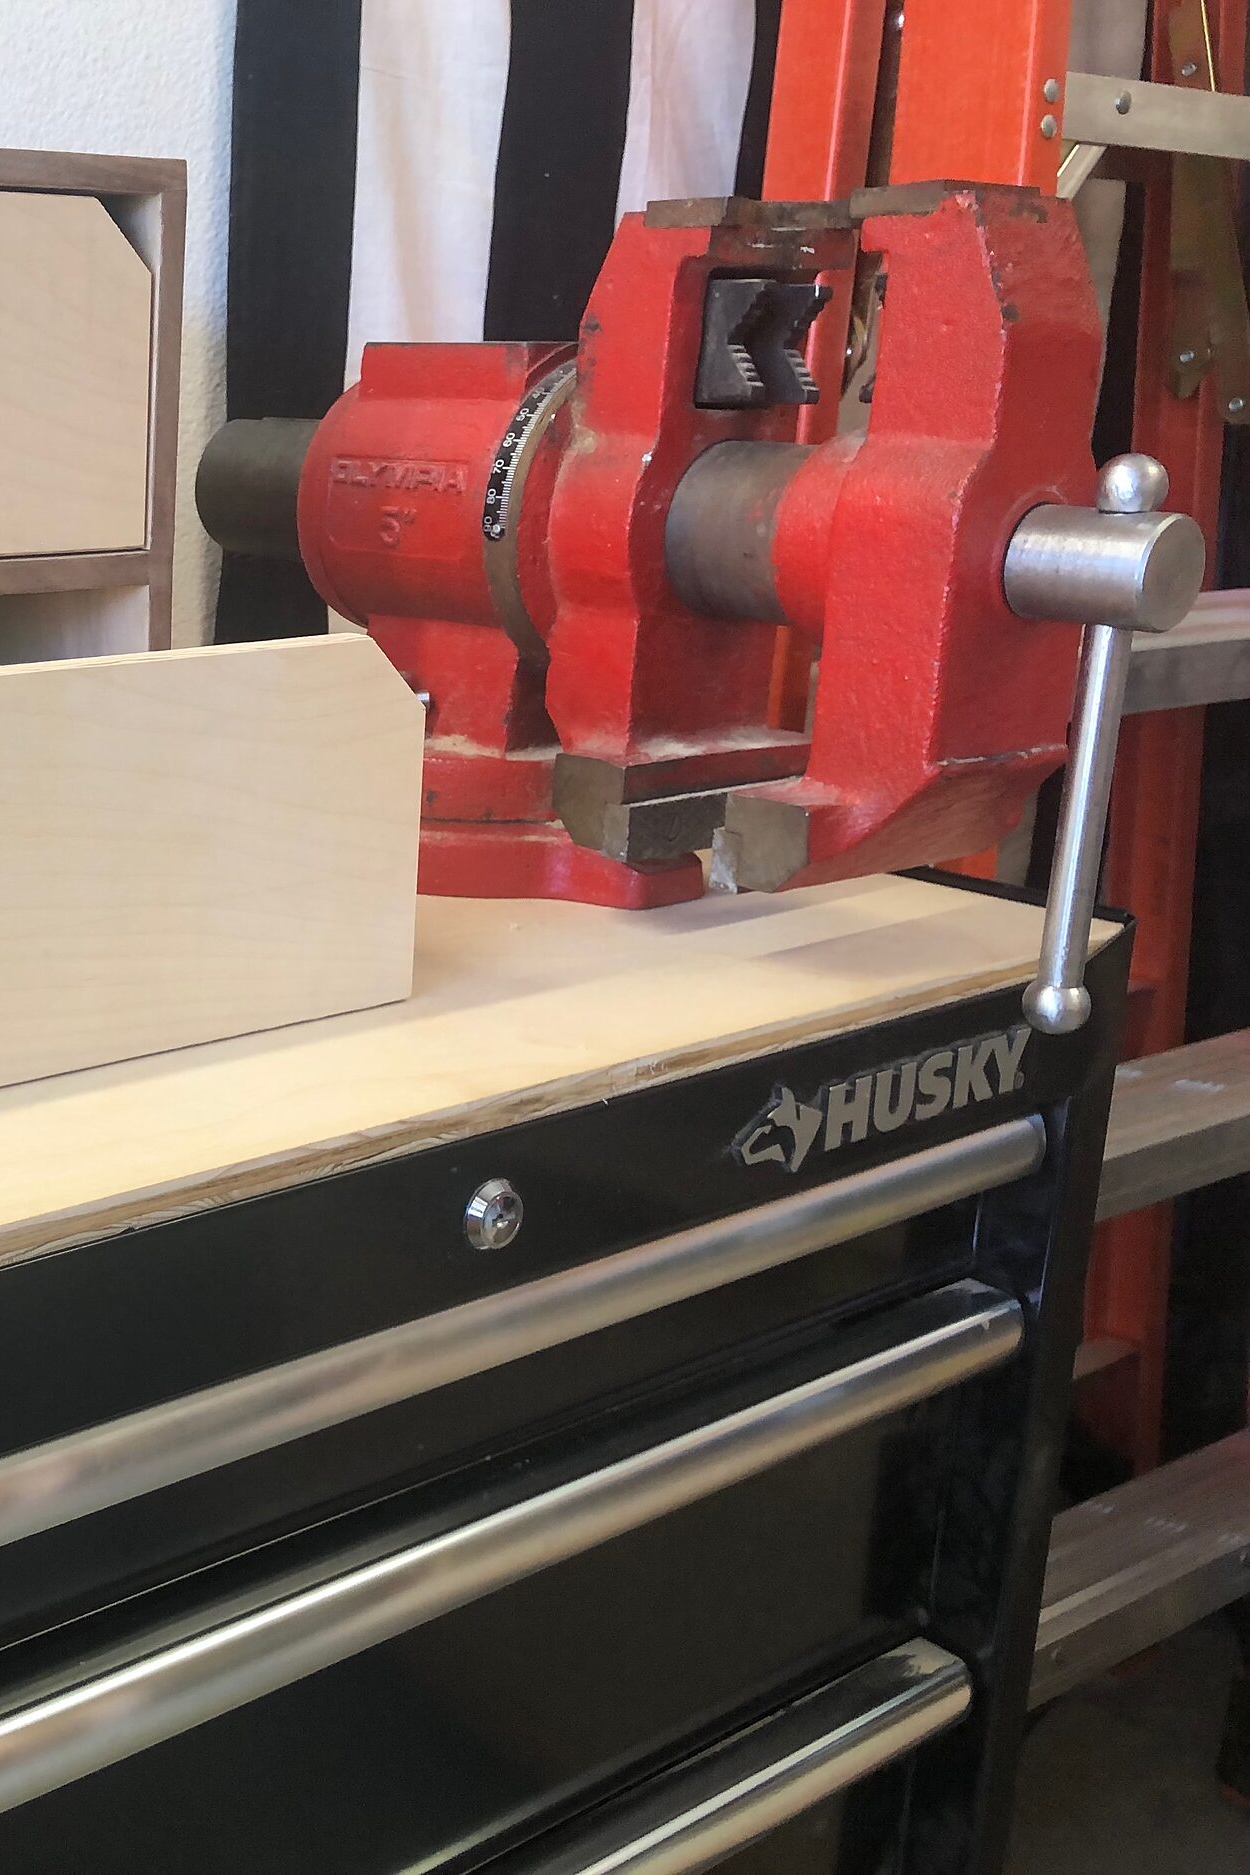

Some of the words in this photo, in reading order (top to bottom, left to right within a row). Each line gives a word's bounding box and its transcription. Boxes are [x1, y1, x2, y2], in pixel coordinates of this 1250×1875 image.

[486, 488, 497, 505] 80
[492, 459, 505, 475] 70
[502, 432, 516, 448] 60
[515, 408, 530, 422] 50
[824, 1027, 1032, 1151] HUSKY
